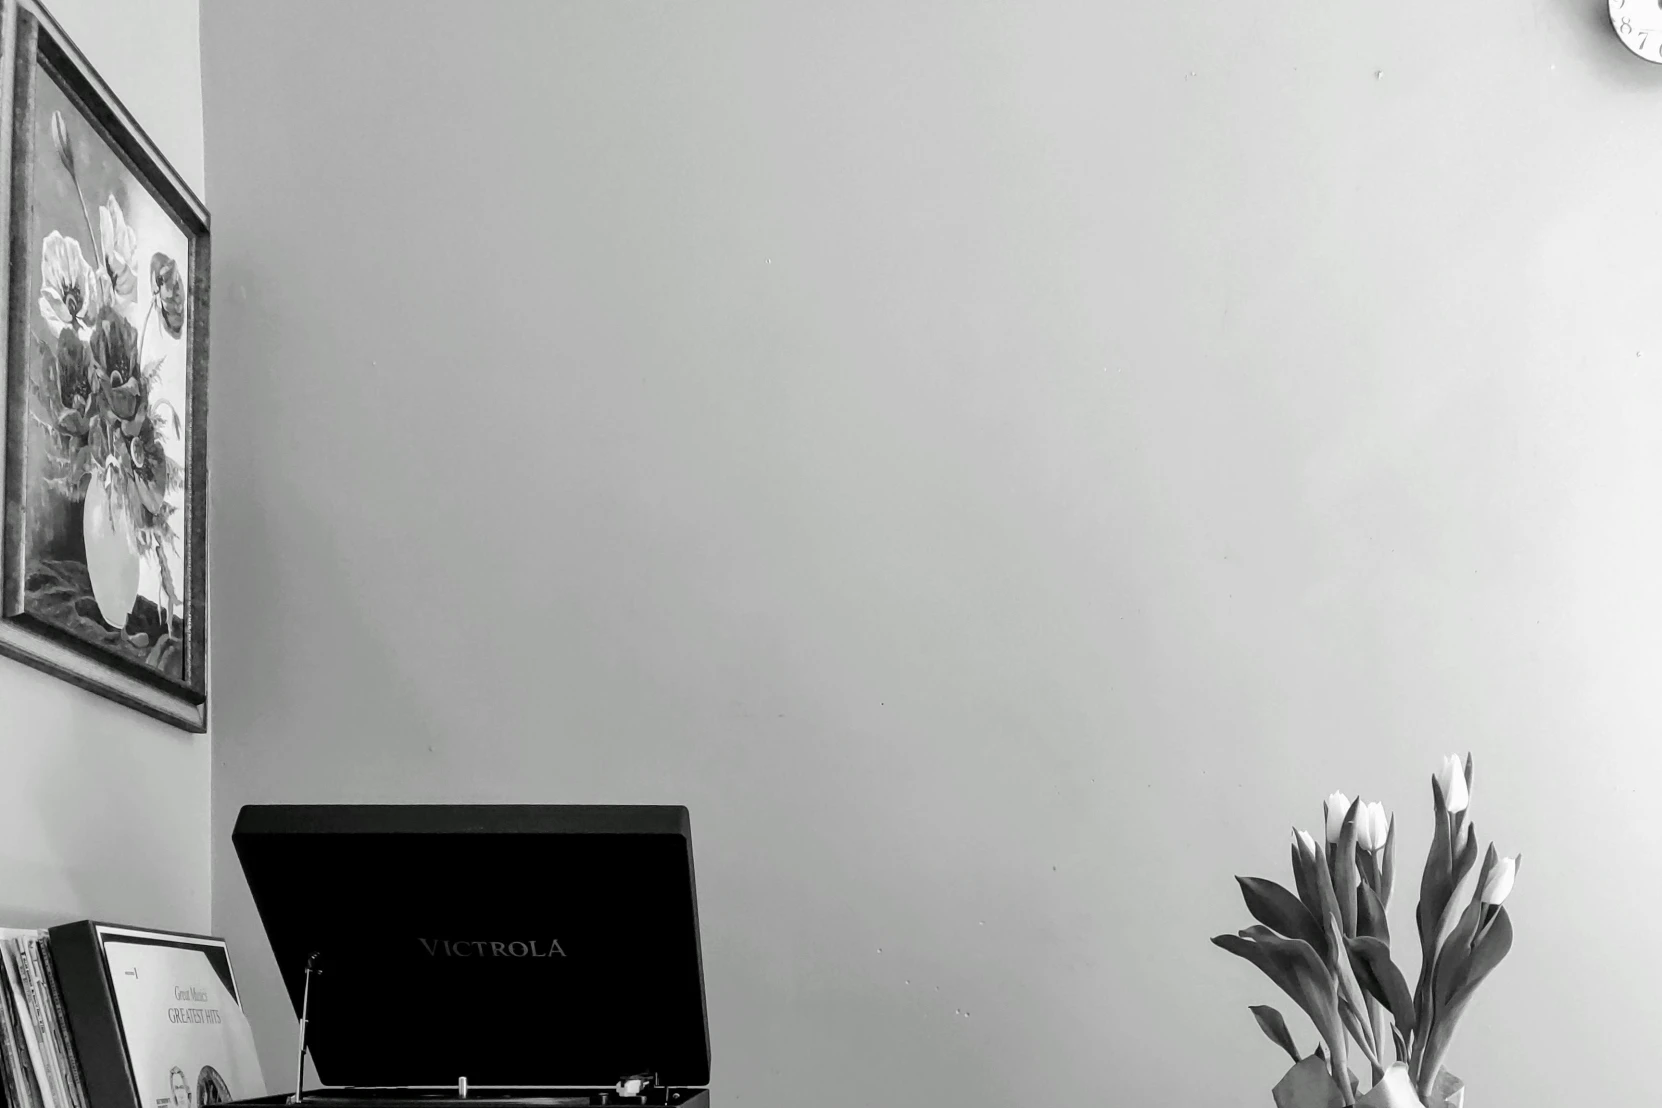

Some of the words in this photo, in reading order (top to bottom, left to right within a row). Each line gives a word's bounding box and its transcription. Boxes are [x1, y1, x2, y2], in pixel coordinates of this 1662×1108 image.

[1620, 16, 1632, 35] 8
[1638, 32, 1648, 50] 7
[417, 937, 567, 957] VICTROLA
[168, 1007, 204, 1024] GREATEST
[204, 1009, 222, 1024] HITS
